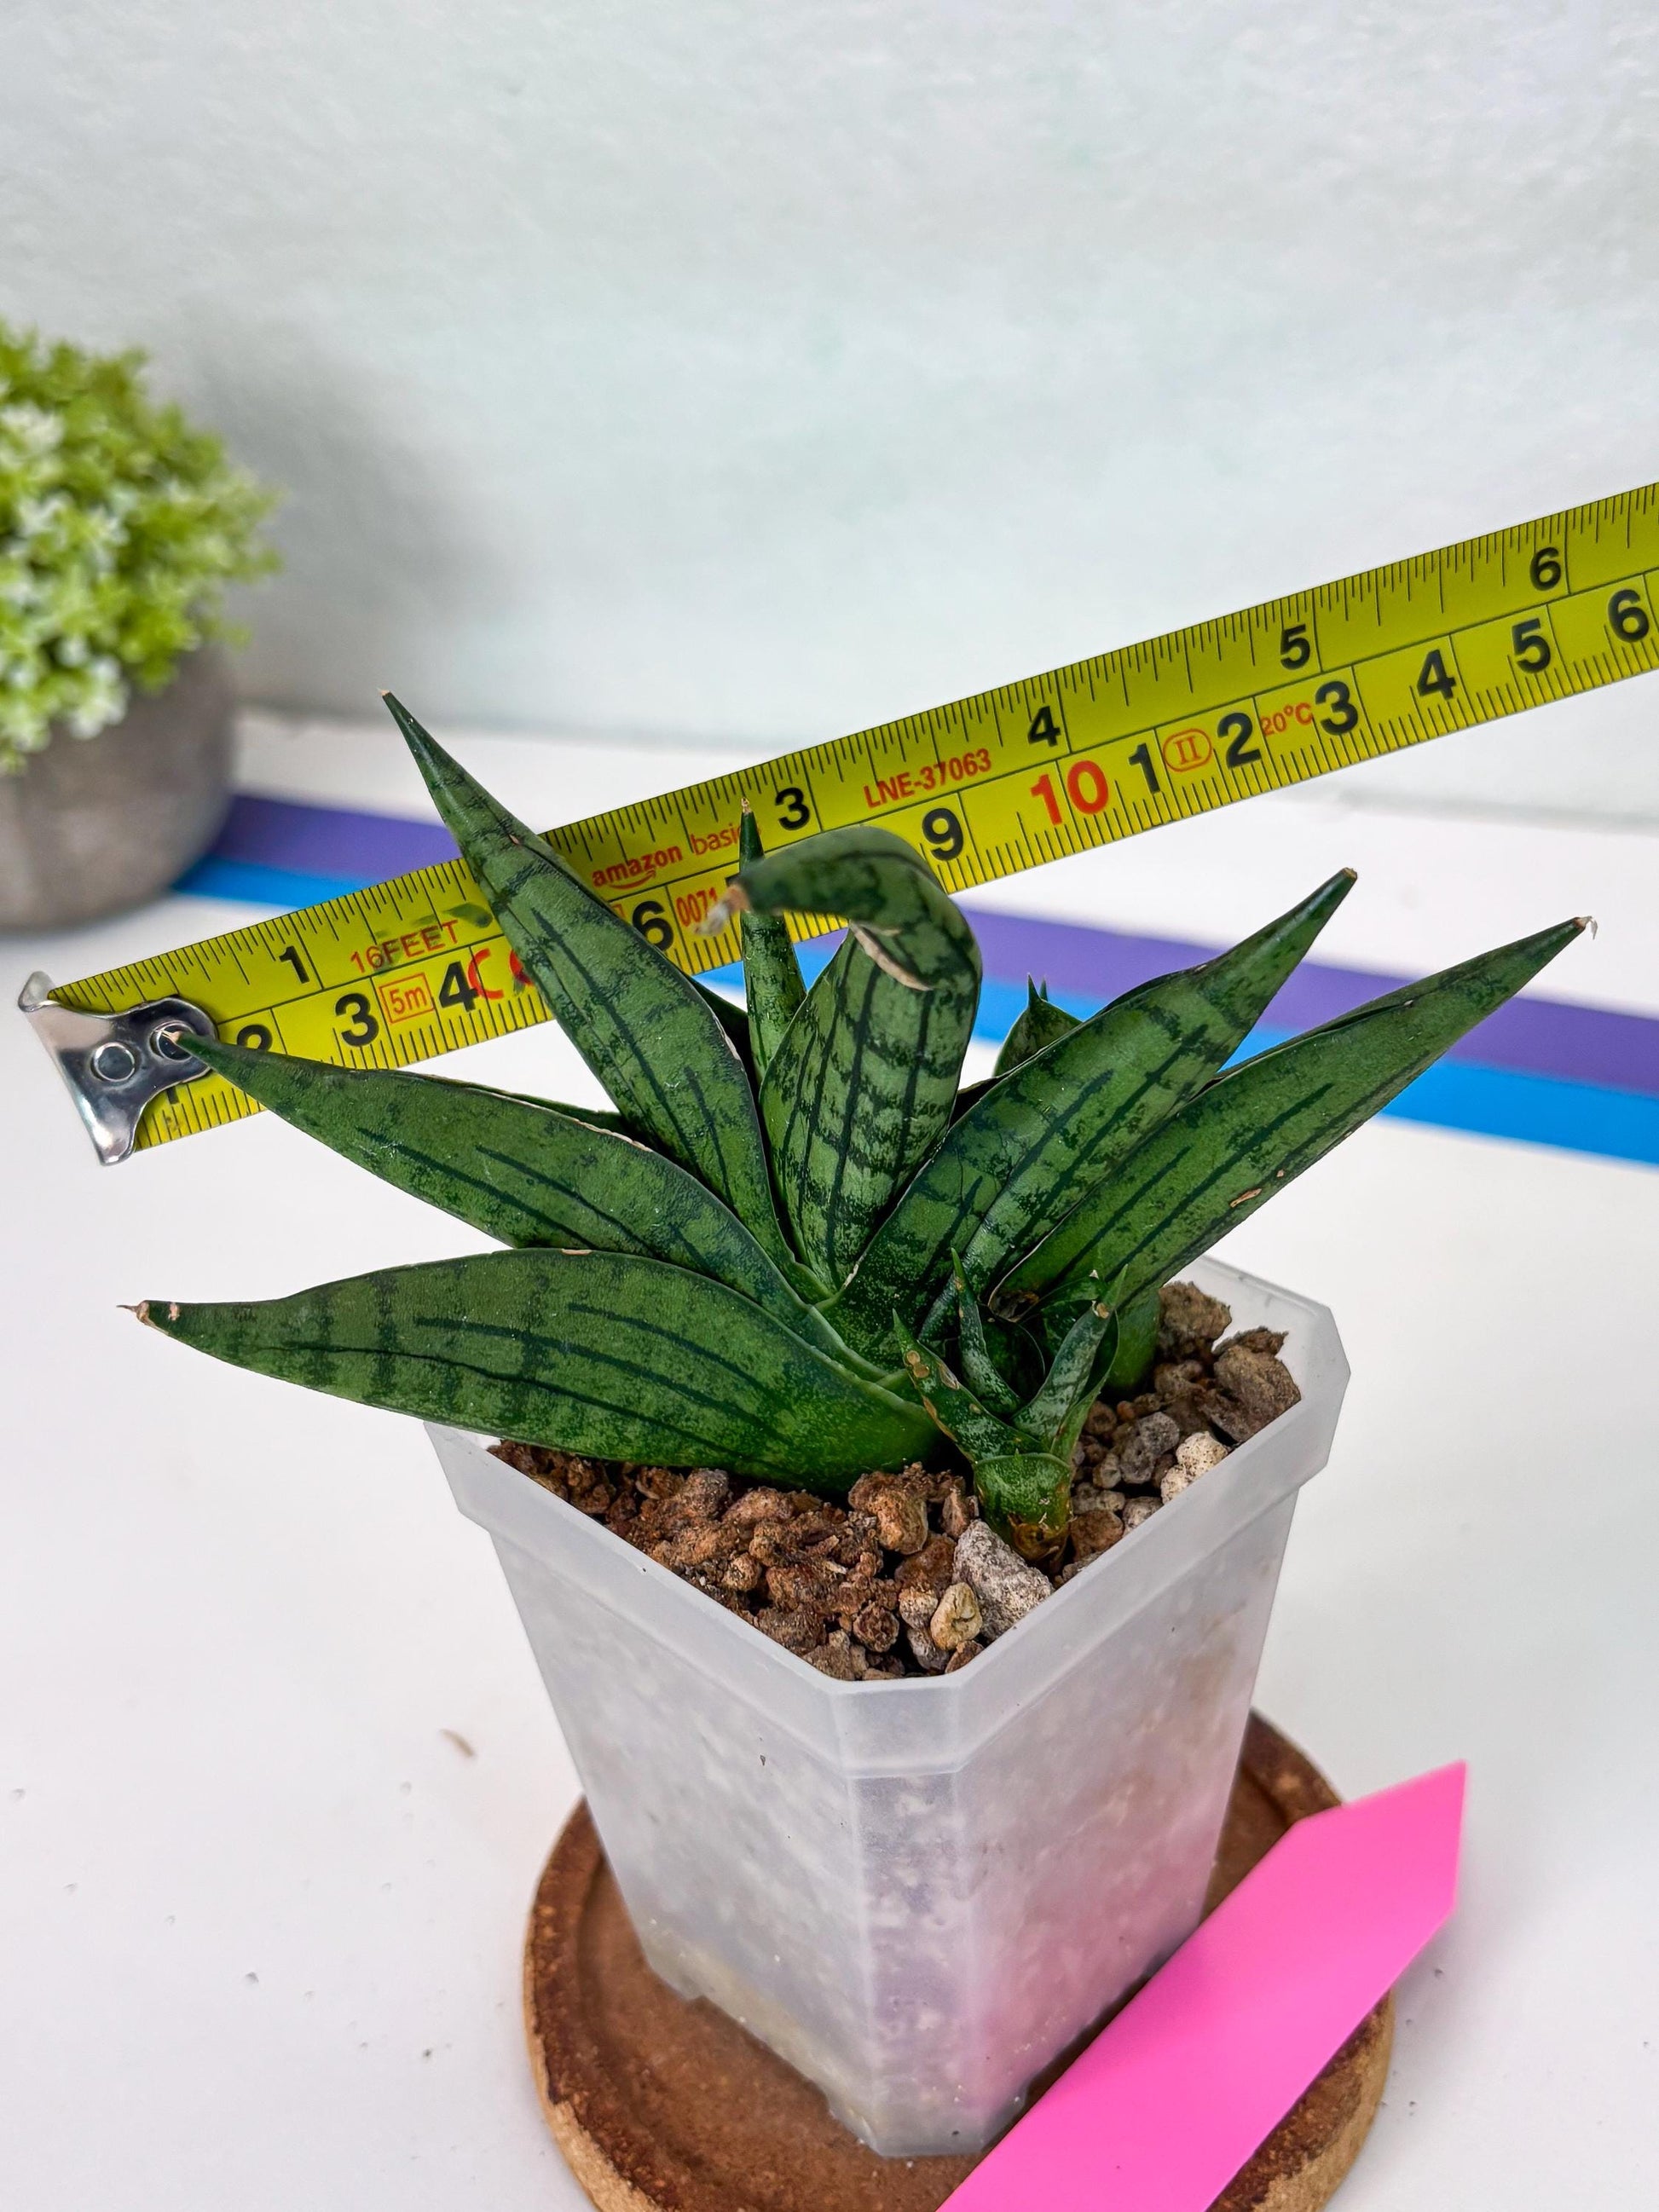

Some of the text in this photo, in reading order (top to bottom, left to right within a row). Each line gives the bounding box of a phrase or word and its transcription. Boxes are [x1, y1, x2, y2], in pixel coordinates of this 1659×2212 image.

[1530, 547, 1563, 591] 6
[1607, 589, 1650, 643] 6
[1280, 624, 1311, 671] 5
[1511, 618, 1552, 673] 5
[1415, 649, 1456, 700] 4
[1027, 706, 1061, 747] 4
[1315, 681, 1359, 736] 3
[1217, 712, 1262, 769] 2
[863, 748, 991, 809] LNE-37063
[1031, 759, 1108, 825] 10
[1128, 742, 1160, 794] 1
[775, 787, 810, 831] 3
[922, 808, 963, 861] 9
[592, 823, 761, 889] amazon basi
[632, 900, 673, 952] 6
[279, 946, 309, 984] 1
[438, 961, 479, 1013] 4
[334, 993, 379, 1047] 3
[390, 988, 427, 1014] 5m
